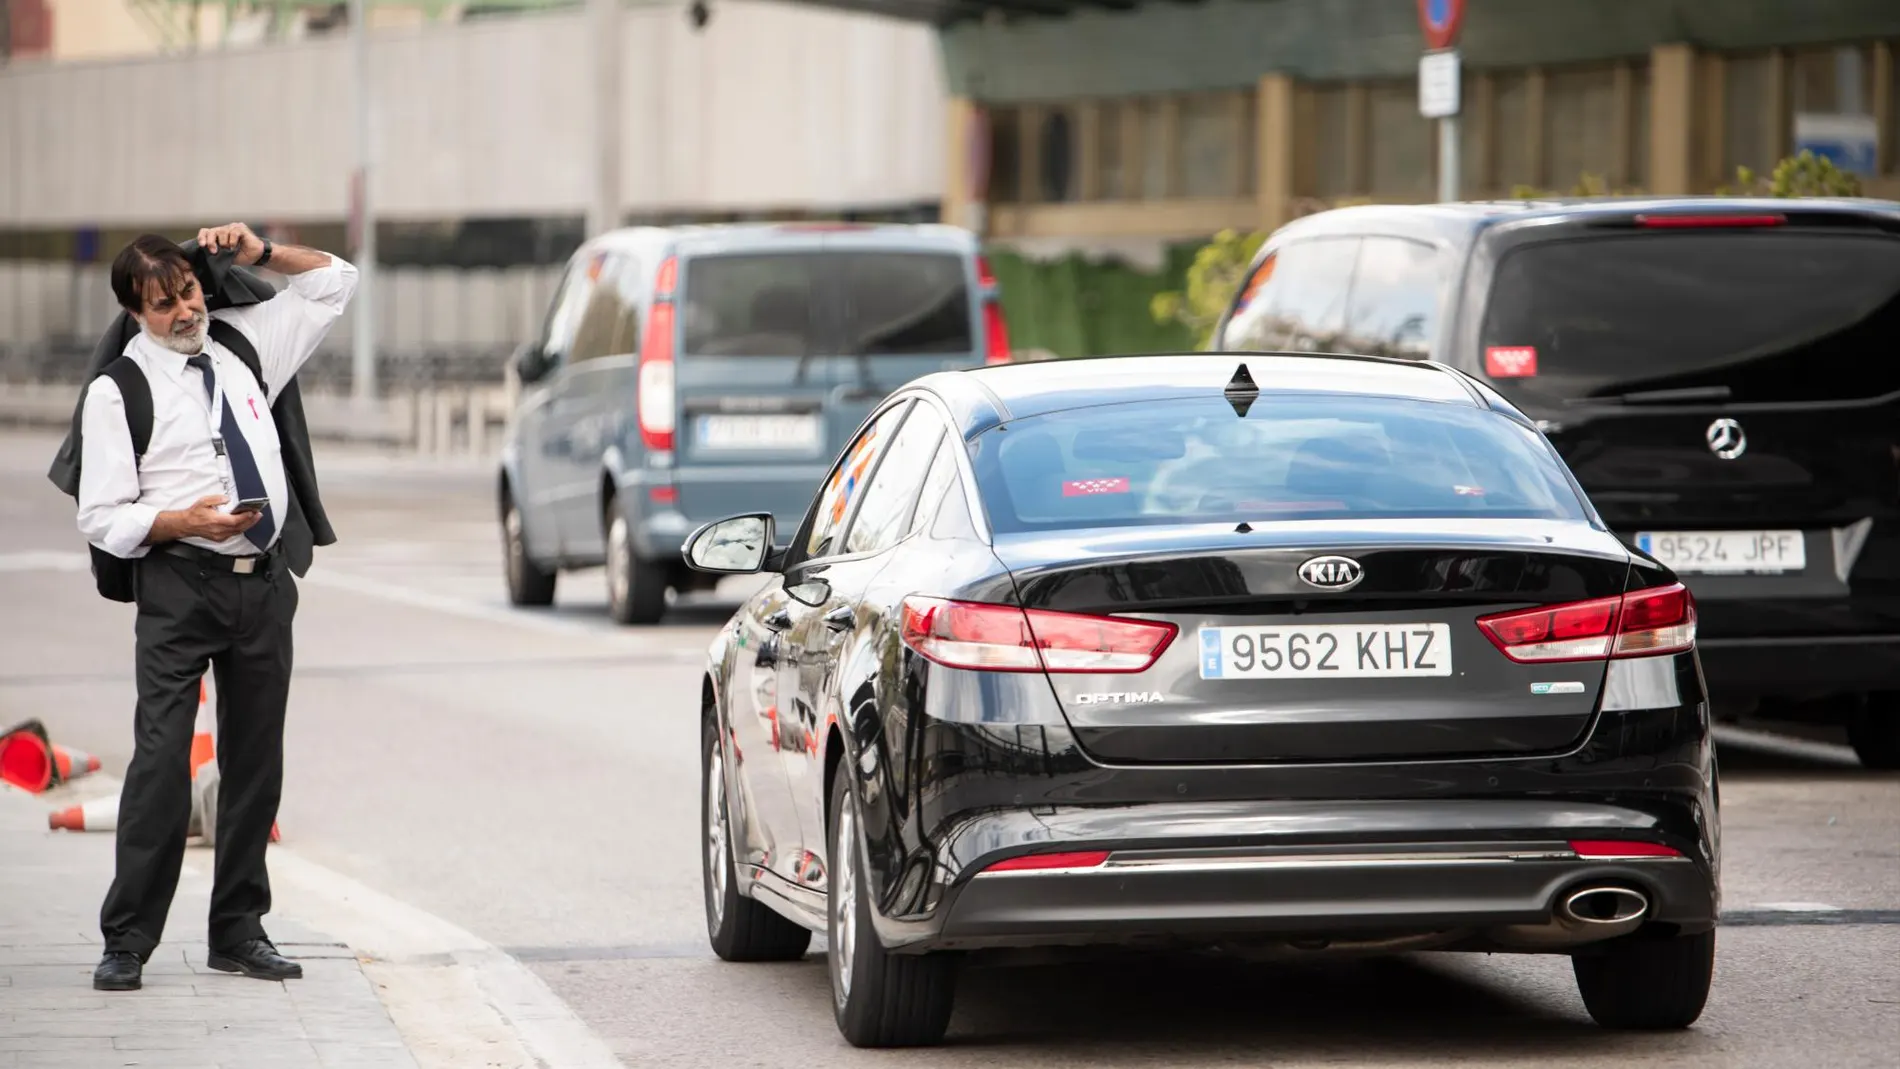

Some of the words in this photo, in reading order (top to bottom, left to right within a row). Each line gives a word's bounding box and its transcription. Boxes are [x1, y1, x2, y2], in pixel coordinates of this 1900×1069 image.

[1659, 537, 1728, 562] 9524
[1744, 535, 1793, 560] JPF
[1310, 563, 1353, 582] KIA
[1231, 632, 1341, 672] 9562
[1355, 630, 1437, 670] KHZ
[1207, 657, 1217, 669] E
[1076, 691, 1165, 704] OPTIMA
